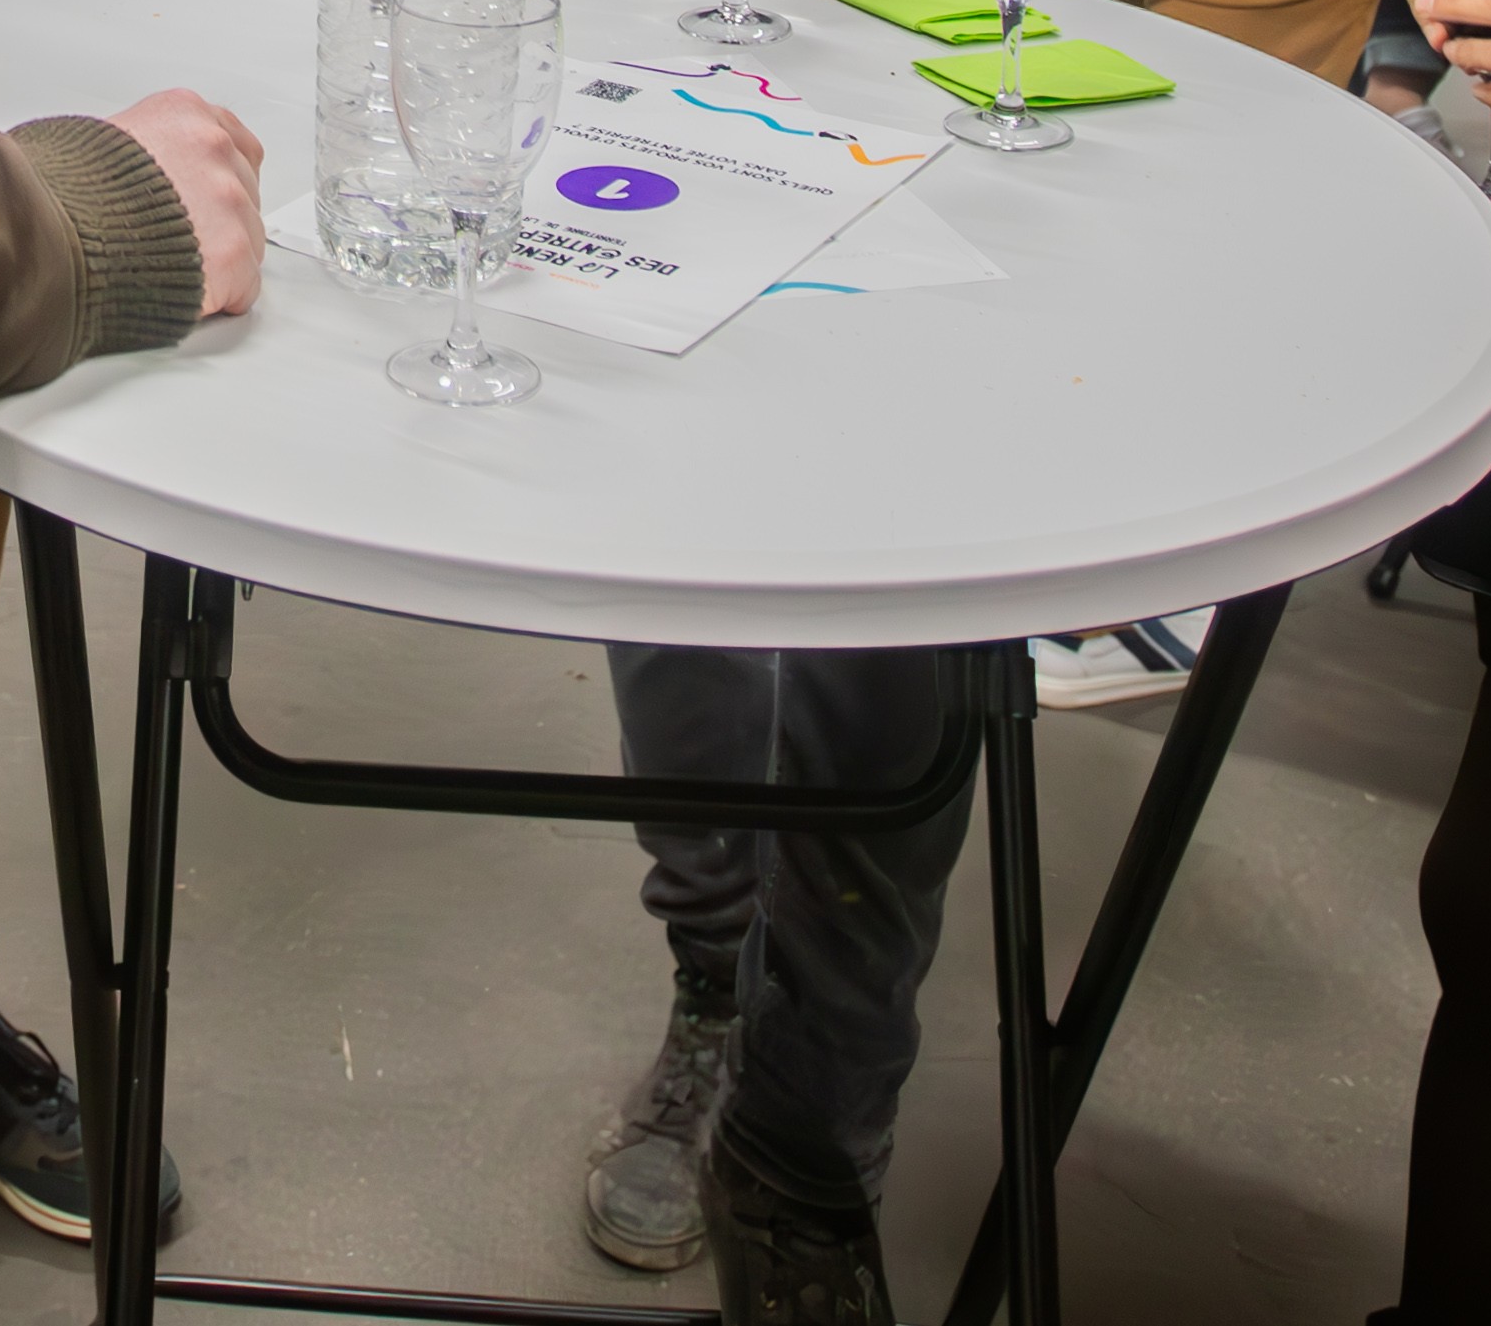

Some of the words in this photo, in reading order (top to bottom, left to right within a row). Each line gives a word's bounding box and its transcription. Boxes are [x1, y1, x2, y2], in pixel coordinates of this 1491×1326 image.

[585, 126, 682, 154] ENTREPRISE
[618, 142, 690, 163] PROJETS
[686, 149, 737, 165] VOTRE
[693, 160, 724, 171] VOS
[742, 162, 787, 177] DANS
[728, 168, 775, 183] SONT
[595, 179, 631, 200] 1
[778, 179, 834, 196] QUELS
[543, 221, 560, 230] DE
[518, 230, 622, 260] ENTREP
[624, 256, 680, 276] DES
